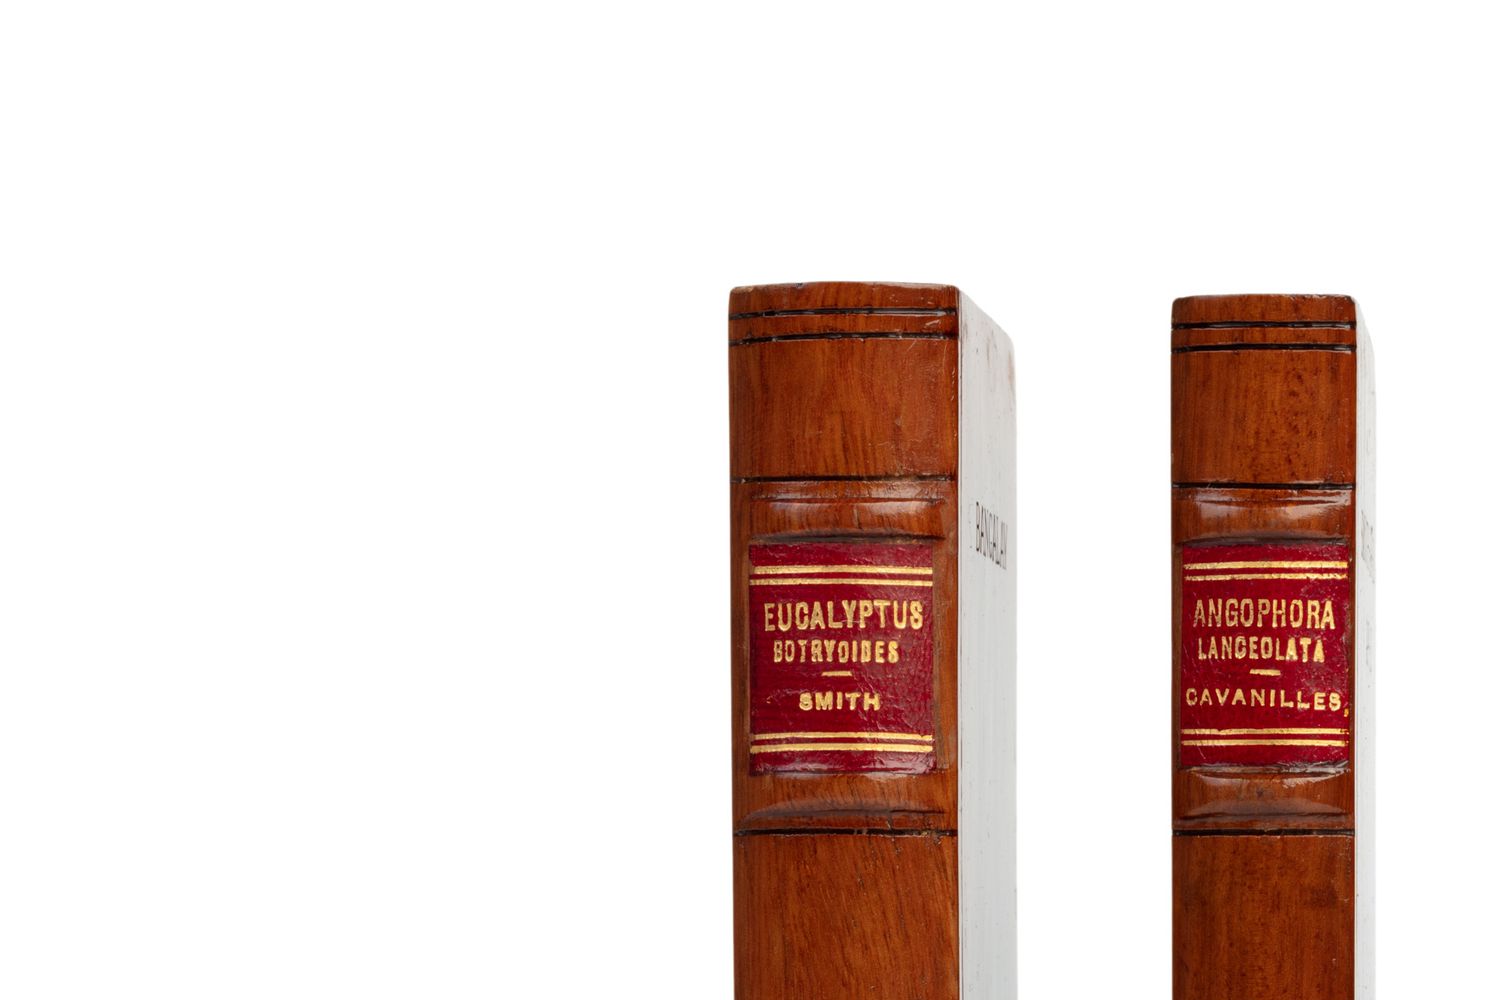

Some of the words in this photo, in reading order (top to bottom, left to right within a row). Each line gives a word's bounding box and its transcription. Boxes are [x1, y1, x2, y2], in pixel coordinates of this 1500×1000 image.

[765, 599, 924, 633] EUCALYPTUS
[1193, 598, 1336, 630] ANGOPHORA
[1198, 635, 1326, 664] LANCEOLATA
[799, 691, 881, 712] SMITH
